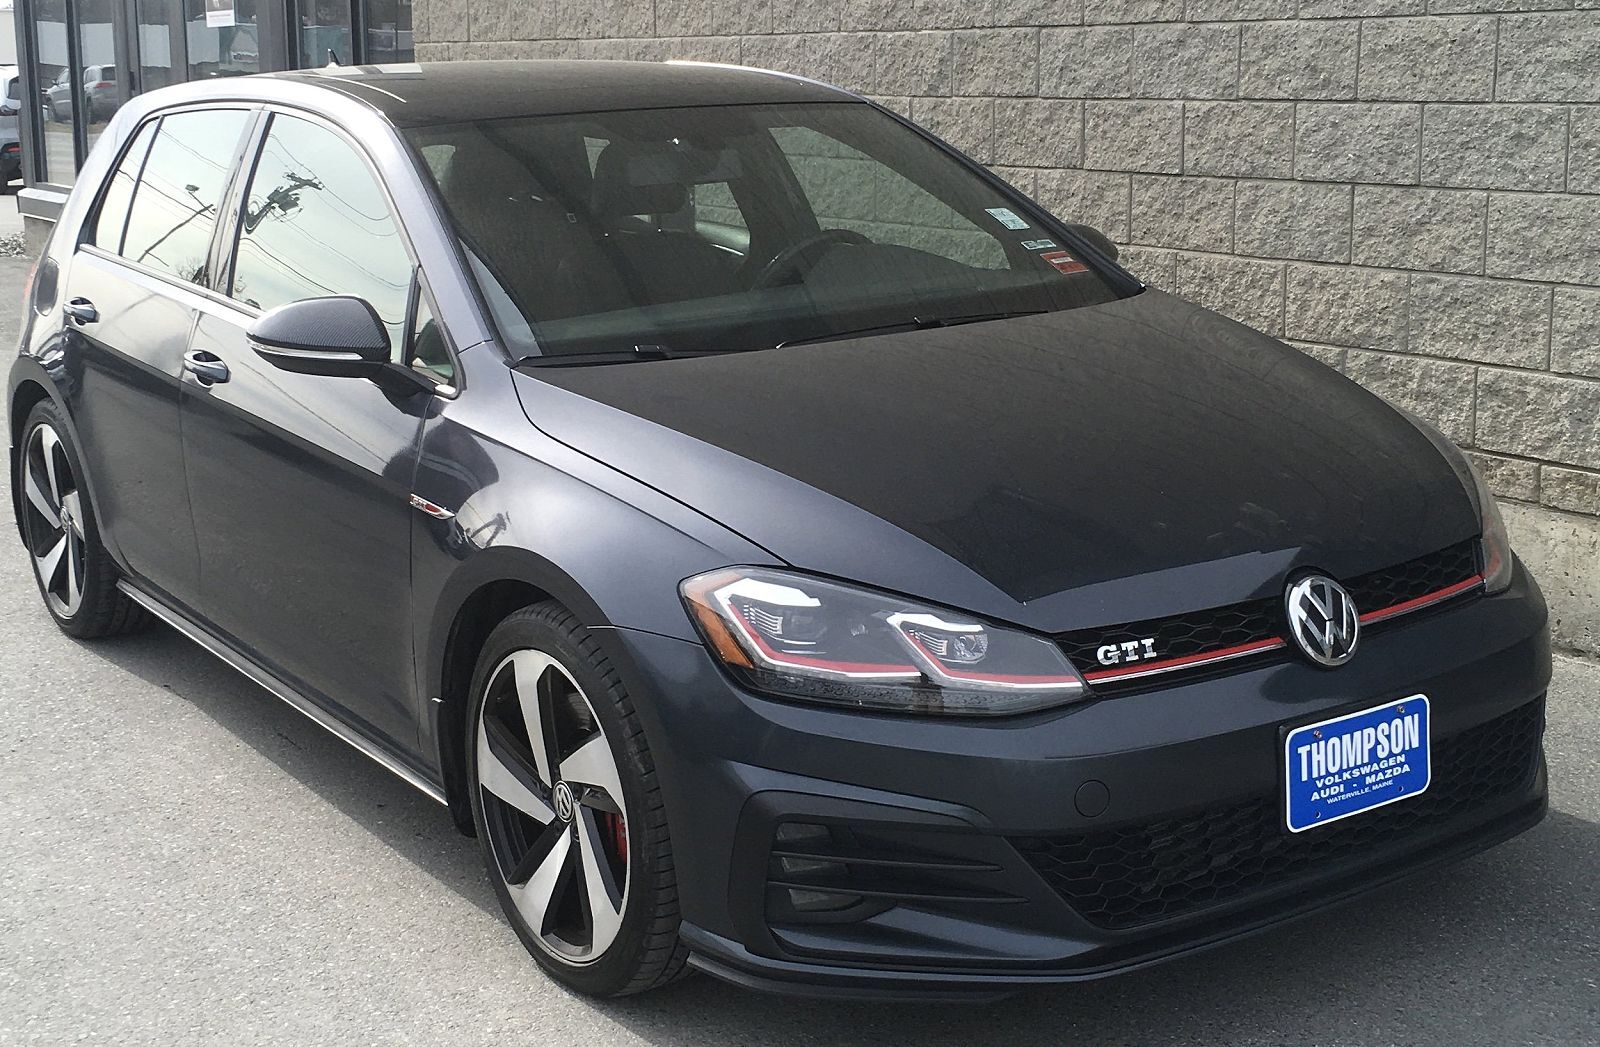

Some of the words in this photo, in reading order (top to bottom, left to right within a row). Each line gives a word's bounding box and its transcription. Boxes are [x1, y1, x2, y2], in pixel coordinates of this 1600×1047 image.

[1097, 638, 1157, 665] GTI
[1298, 713, 1420, 782] THOMPSON
[1311, 784, 1345, 801] AUDI
[1365, 764, 1411, 785] MAZDA
[1316, 754, 1405, 788] VOLKSWAGEN
[1372, 780, 1394, 791] MAINE
